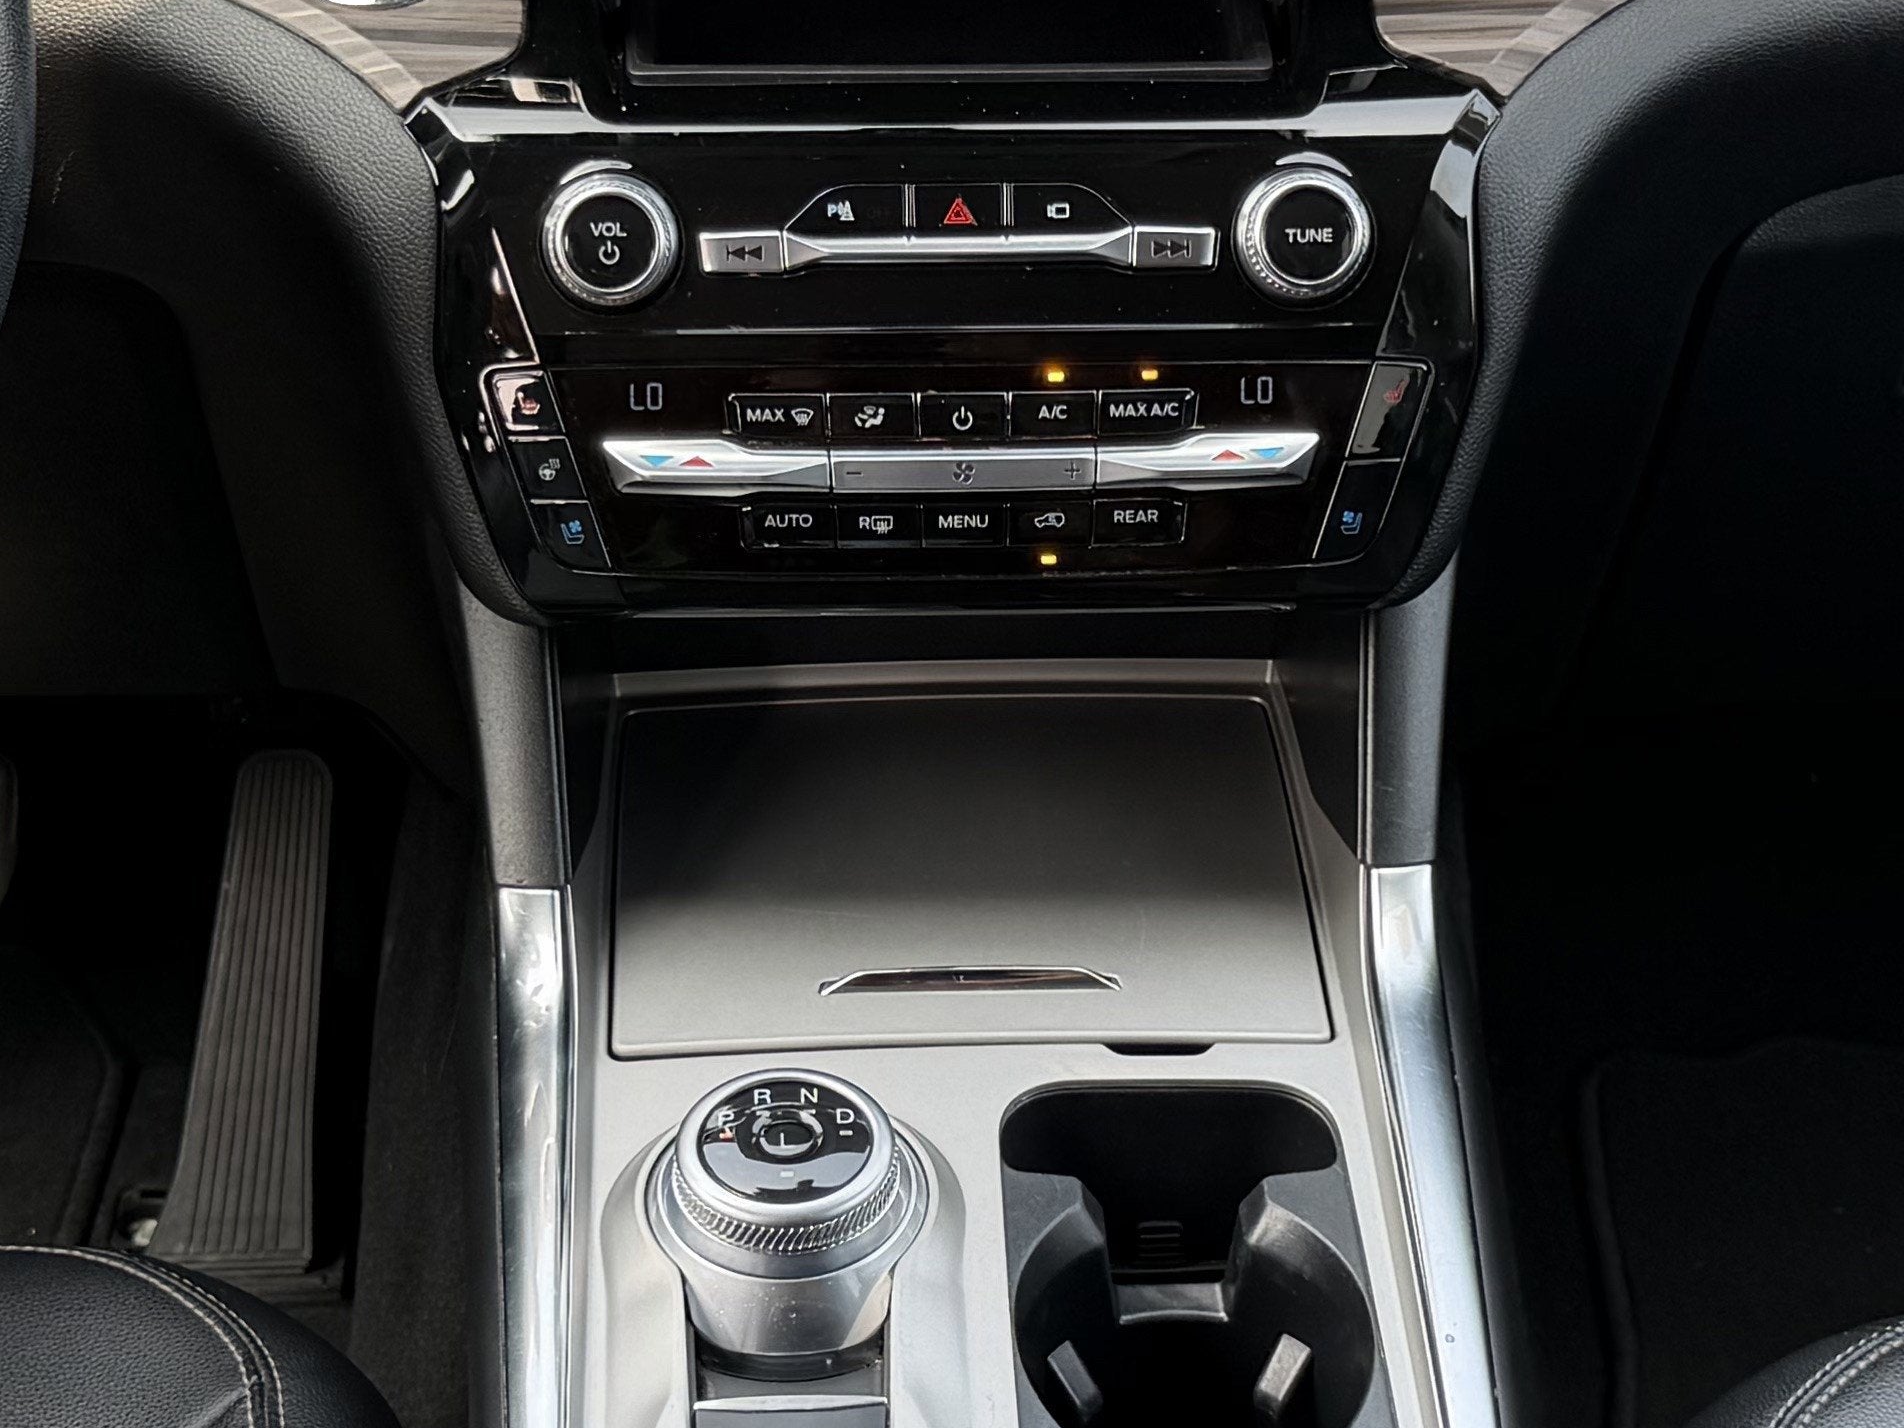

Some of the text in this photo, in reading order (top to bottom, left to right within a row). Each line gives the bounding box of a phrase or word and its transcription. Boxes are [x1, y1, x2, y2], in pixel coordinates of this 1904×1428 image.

[589, 222, 627, 237] VOL
[1284, 227, 1333, 243] TUNE
[629, 381, 664, 412] LO
[1239, 375, 1274, 405] LO
[746, 408, 785, 423] MAX
[1038, 405, 1068, 420] A/C
[1109, 402, 1179, 418] MAX A/C
[764, 513, 813, 529] AUTO
[938, 515, 989, 529] MENU
[1113, 509, 1159, 524] REAR
[717, 1088, 855, 1127] P R N D
